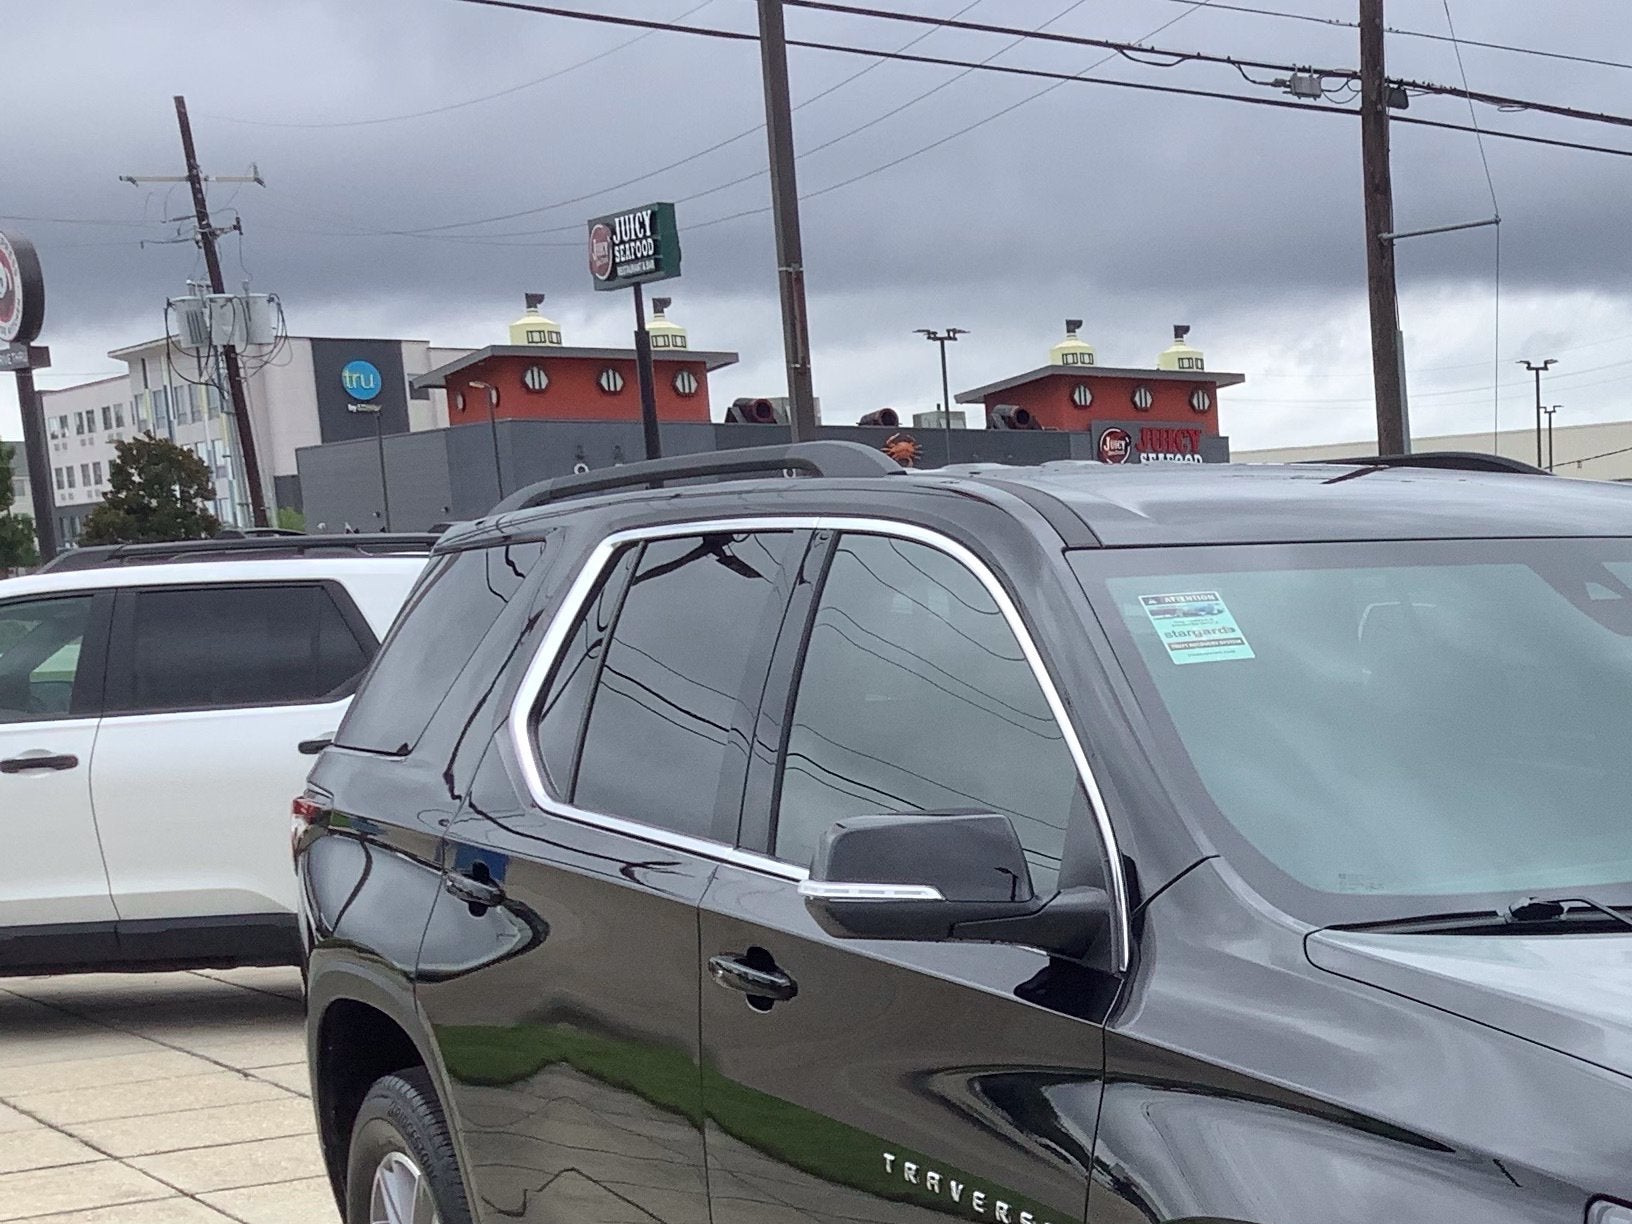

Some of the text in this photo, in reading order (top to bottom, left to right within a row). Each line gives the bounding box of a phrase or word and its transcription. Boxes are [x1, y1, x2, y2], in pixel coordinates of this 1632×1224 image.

[613, 210, 652, 244] JUICY
[614, 238, 654, 262] SEAFOOD
[344, 368, 375, 389] tru
[1136, 427, 1201, 453] JUICY
[1164, 593, 1216, 604] ATTENTION
